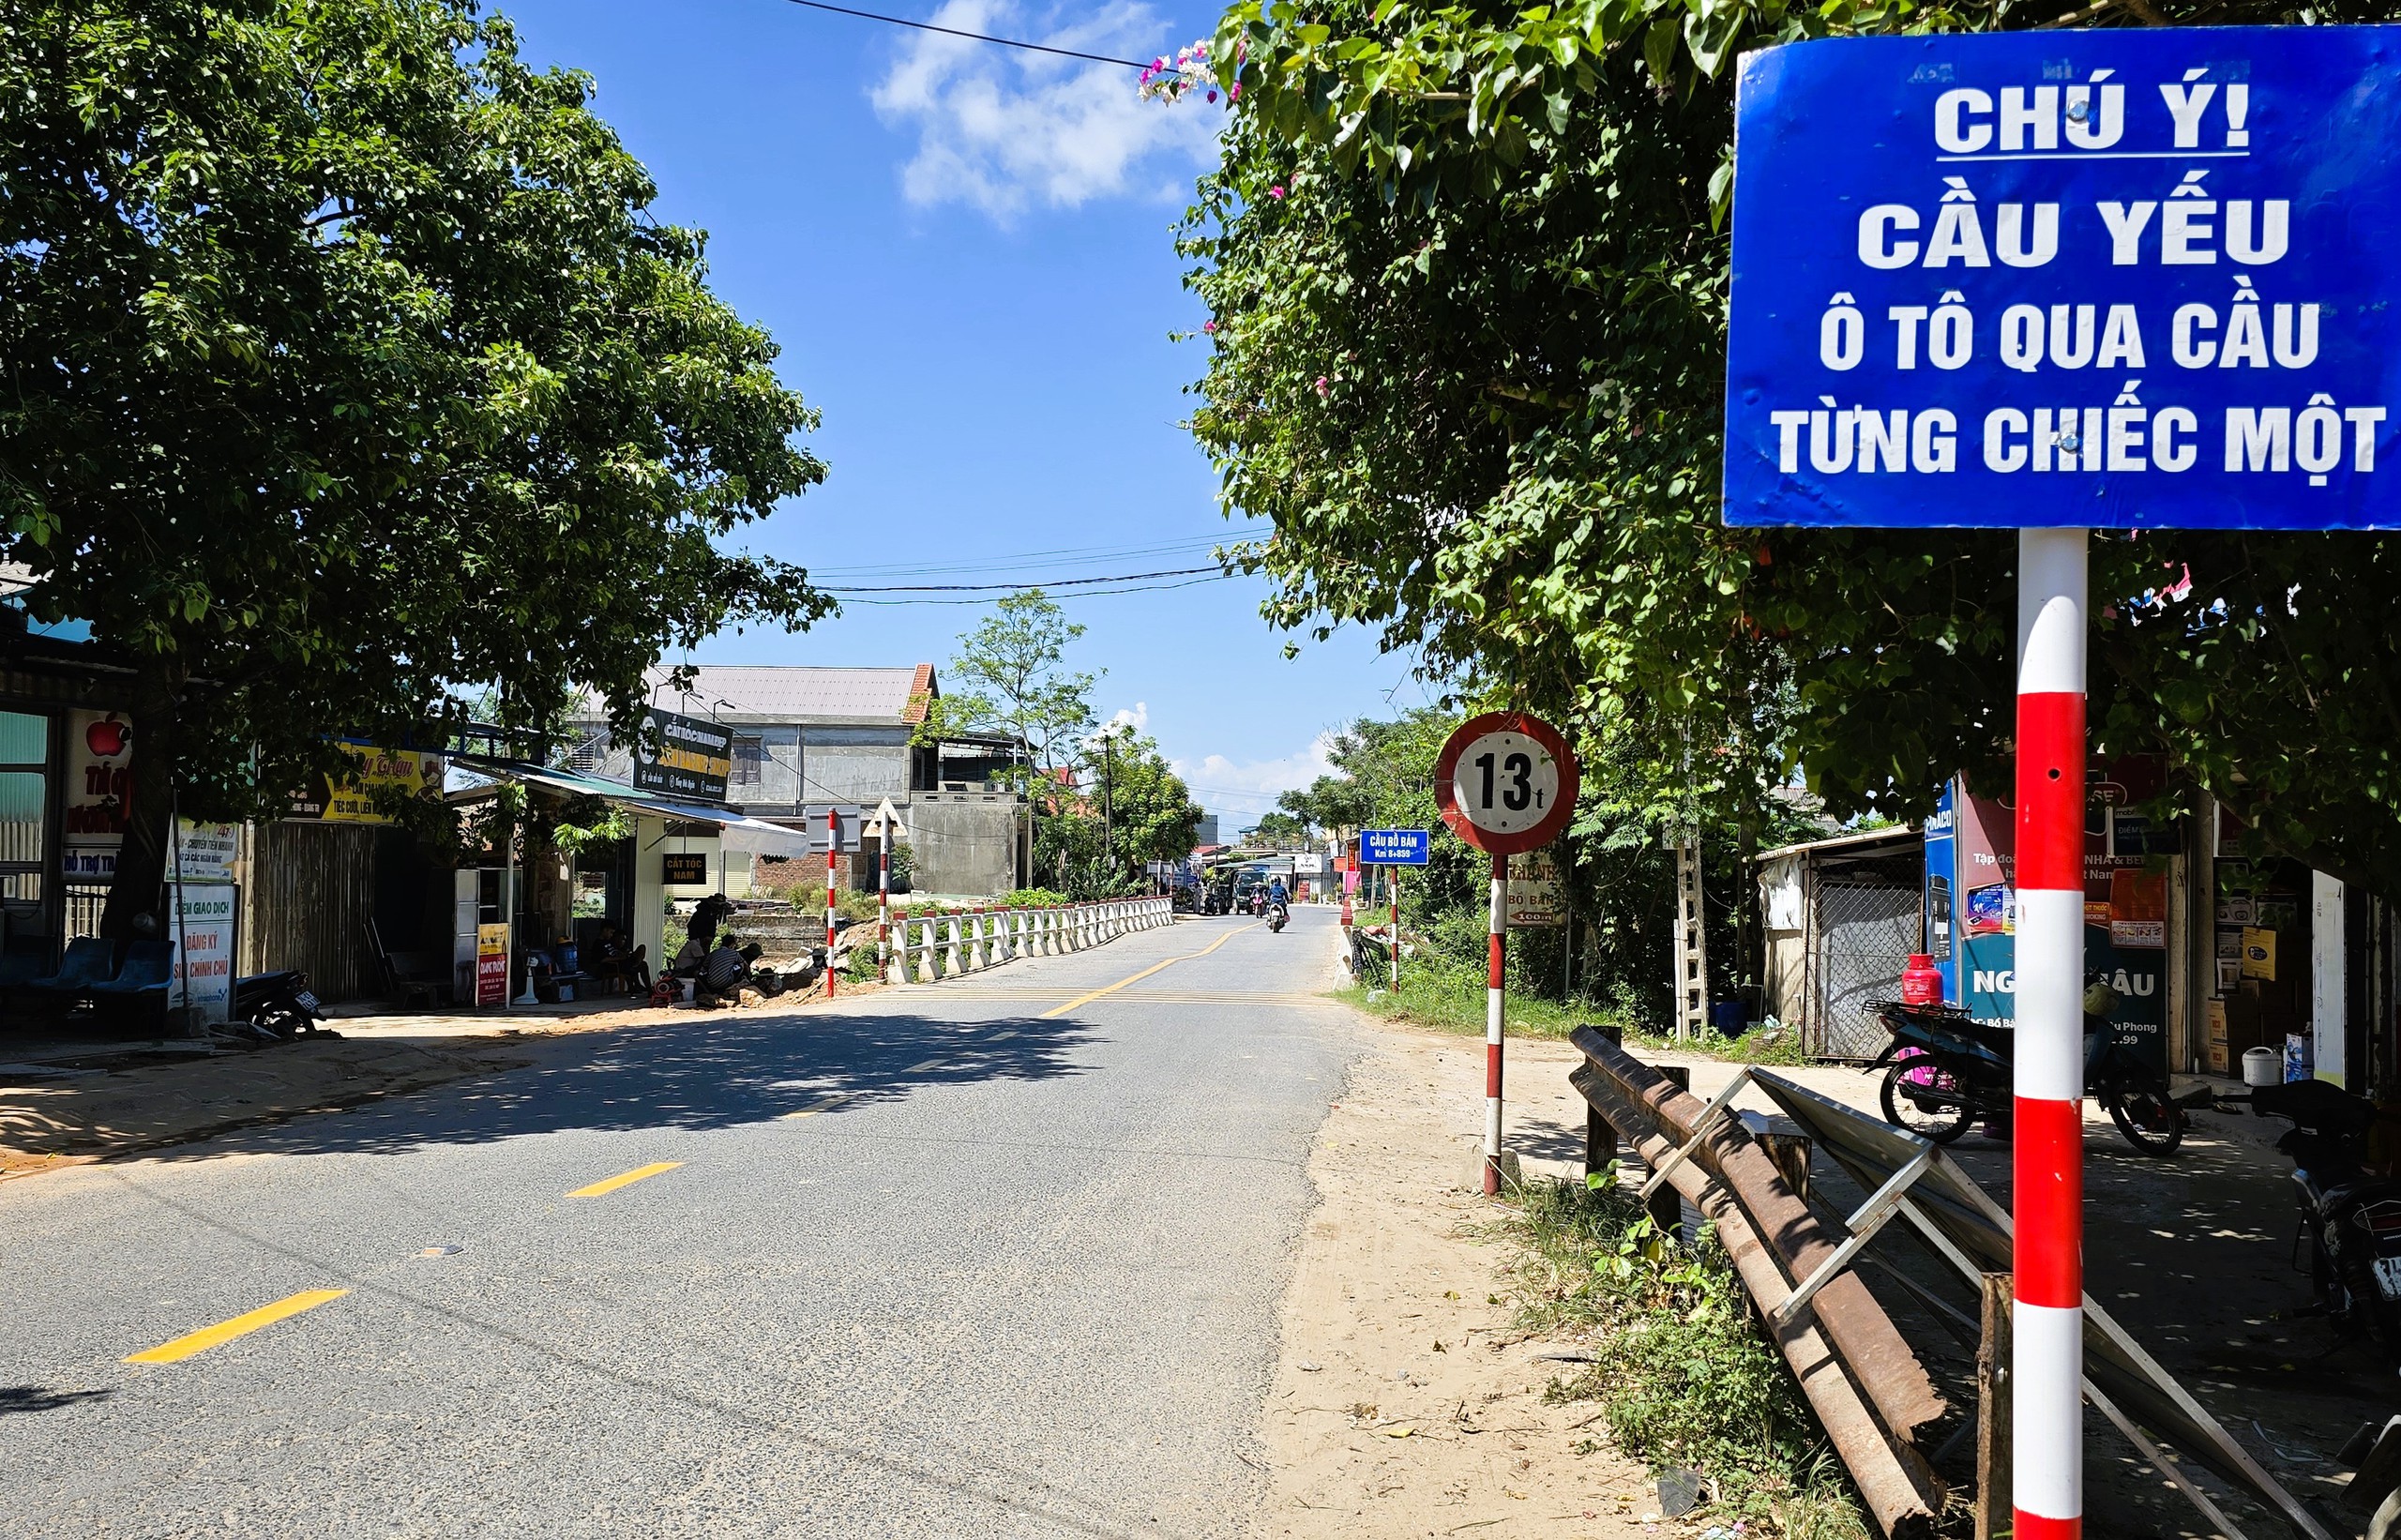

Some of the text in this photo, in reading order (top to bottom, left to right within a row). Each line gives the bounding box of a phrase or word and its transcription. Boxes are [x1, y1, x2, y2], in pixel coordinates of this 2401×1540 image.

[1935, 68, 2250, 153] CHÚ Ý!
[1856, 169, 2291, 269] CẦU YẾU
[1820, 275, 2321, 373] Ô TÔ QUA CẦU
[1770, 379, 2387, 488] TỪNG CHIẾC MỘT
[1369, 831, 1417, 848] CẦU BỒ BẢN
[667, 855, 702, 868] CẮT TÓC
[1374, 849, 1387, 858] Km
[1973, 853, 1996, 866] Tập
[673, 870, 695, 880] NAM
[193, 901, 212, 914] GIAO
[213, 901, 230, 916] DỊCH
[1518, 913, 1552, 921] 100m
[186, 930, 218, 951] ĐĂNG KÝ
[189, 958, 213, 978] CHÍNH
[213, 955, 228, 975] CHỦ
[2122, 1021, 2158, 1034] Phong
